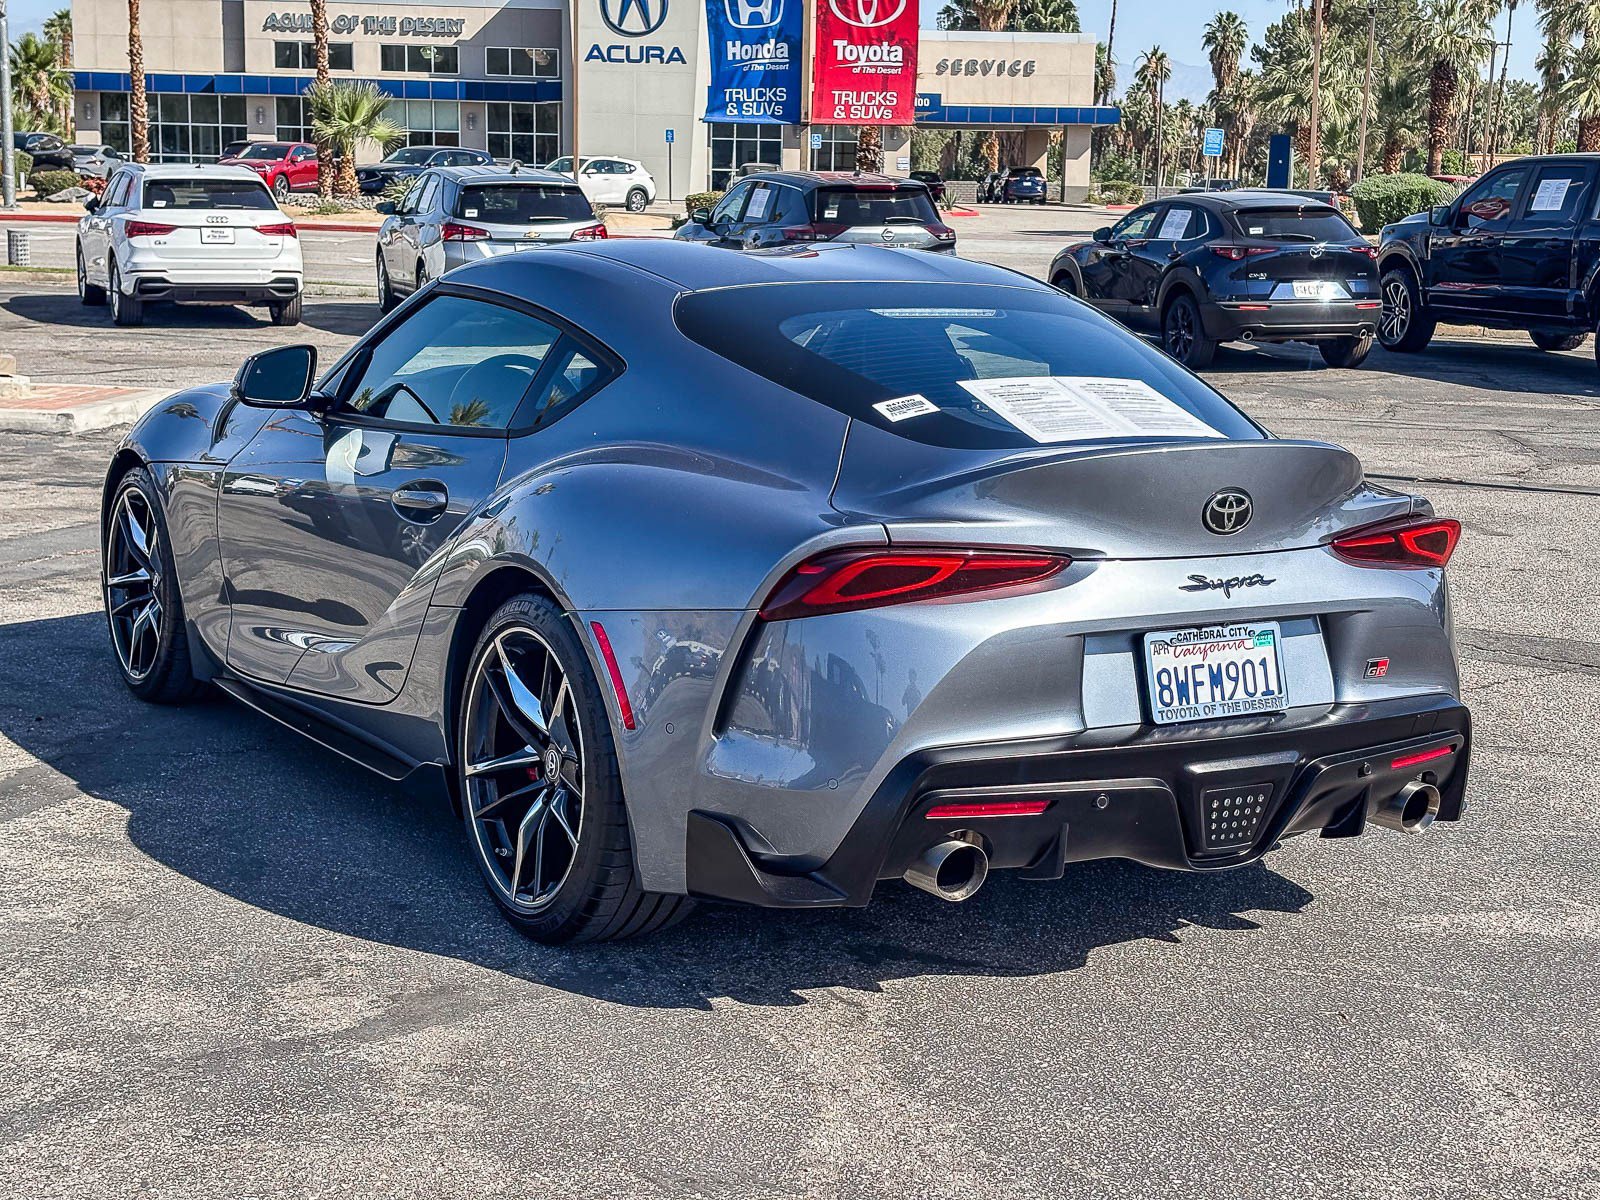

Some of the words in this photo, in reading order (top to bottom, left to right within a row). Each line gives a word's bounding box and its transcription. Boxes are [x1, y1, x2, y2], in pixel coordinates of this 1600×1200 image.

[263, 12, 329, 32] ACUR
[331, 14, 360, 34] OF
[361, 15, 397, 35] THE
[400, 17, 466, 37] DESERT
[584, 43, 688, 64] ACURA
[726, 38, 789, 61] Honda
[832, 39, 903, 64] Toyota
[750, 63, 764, 71] The
[765, 63, 789, 71] Desert
[935, 58, 1036, 78] SERVICE
[724, 87, 788, 102] TRUCKS
[831, 90, 898, 106] TRUCKS
[726, 102, 738, 116] &
[742, 102, 783, 116] SUVs
[834, 106, 847, 119] &
[850, 107, 893, 119] SUVs
[1178, 573, 1277, 599] Supra
[1176, 628, 1227, 643] CATHEDRAL
[1229, 626, 1248, 638] CITY
[1173, 640, 1255, 662] California
[1368, 665, 1386, 676] GR
[1156, 657, 1275, 707] 8WFM901
[1158, 704, 1200, 721] TOYOTA
[1203, 703, 1217, 716] OF
[1219, 700, 1242, 714] THE
[1243, 696, 1285, 711] DESERT
